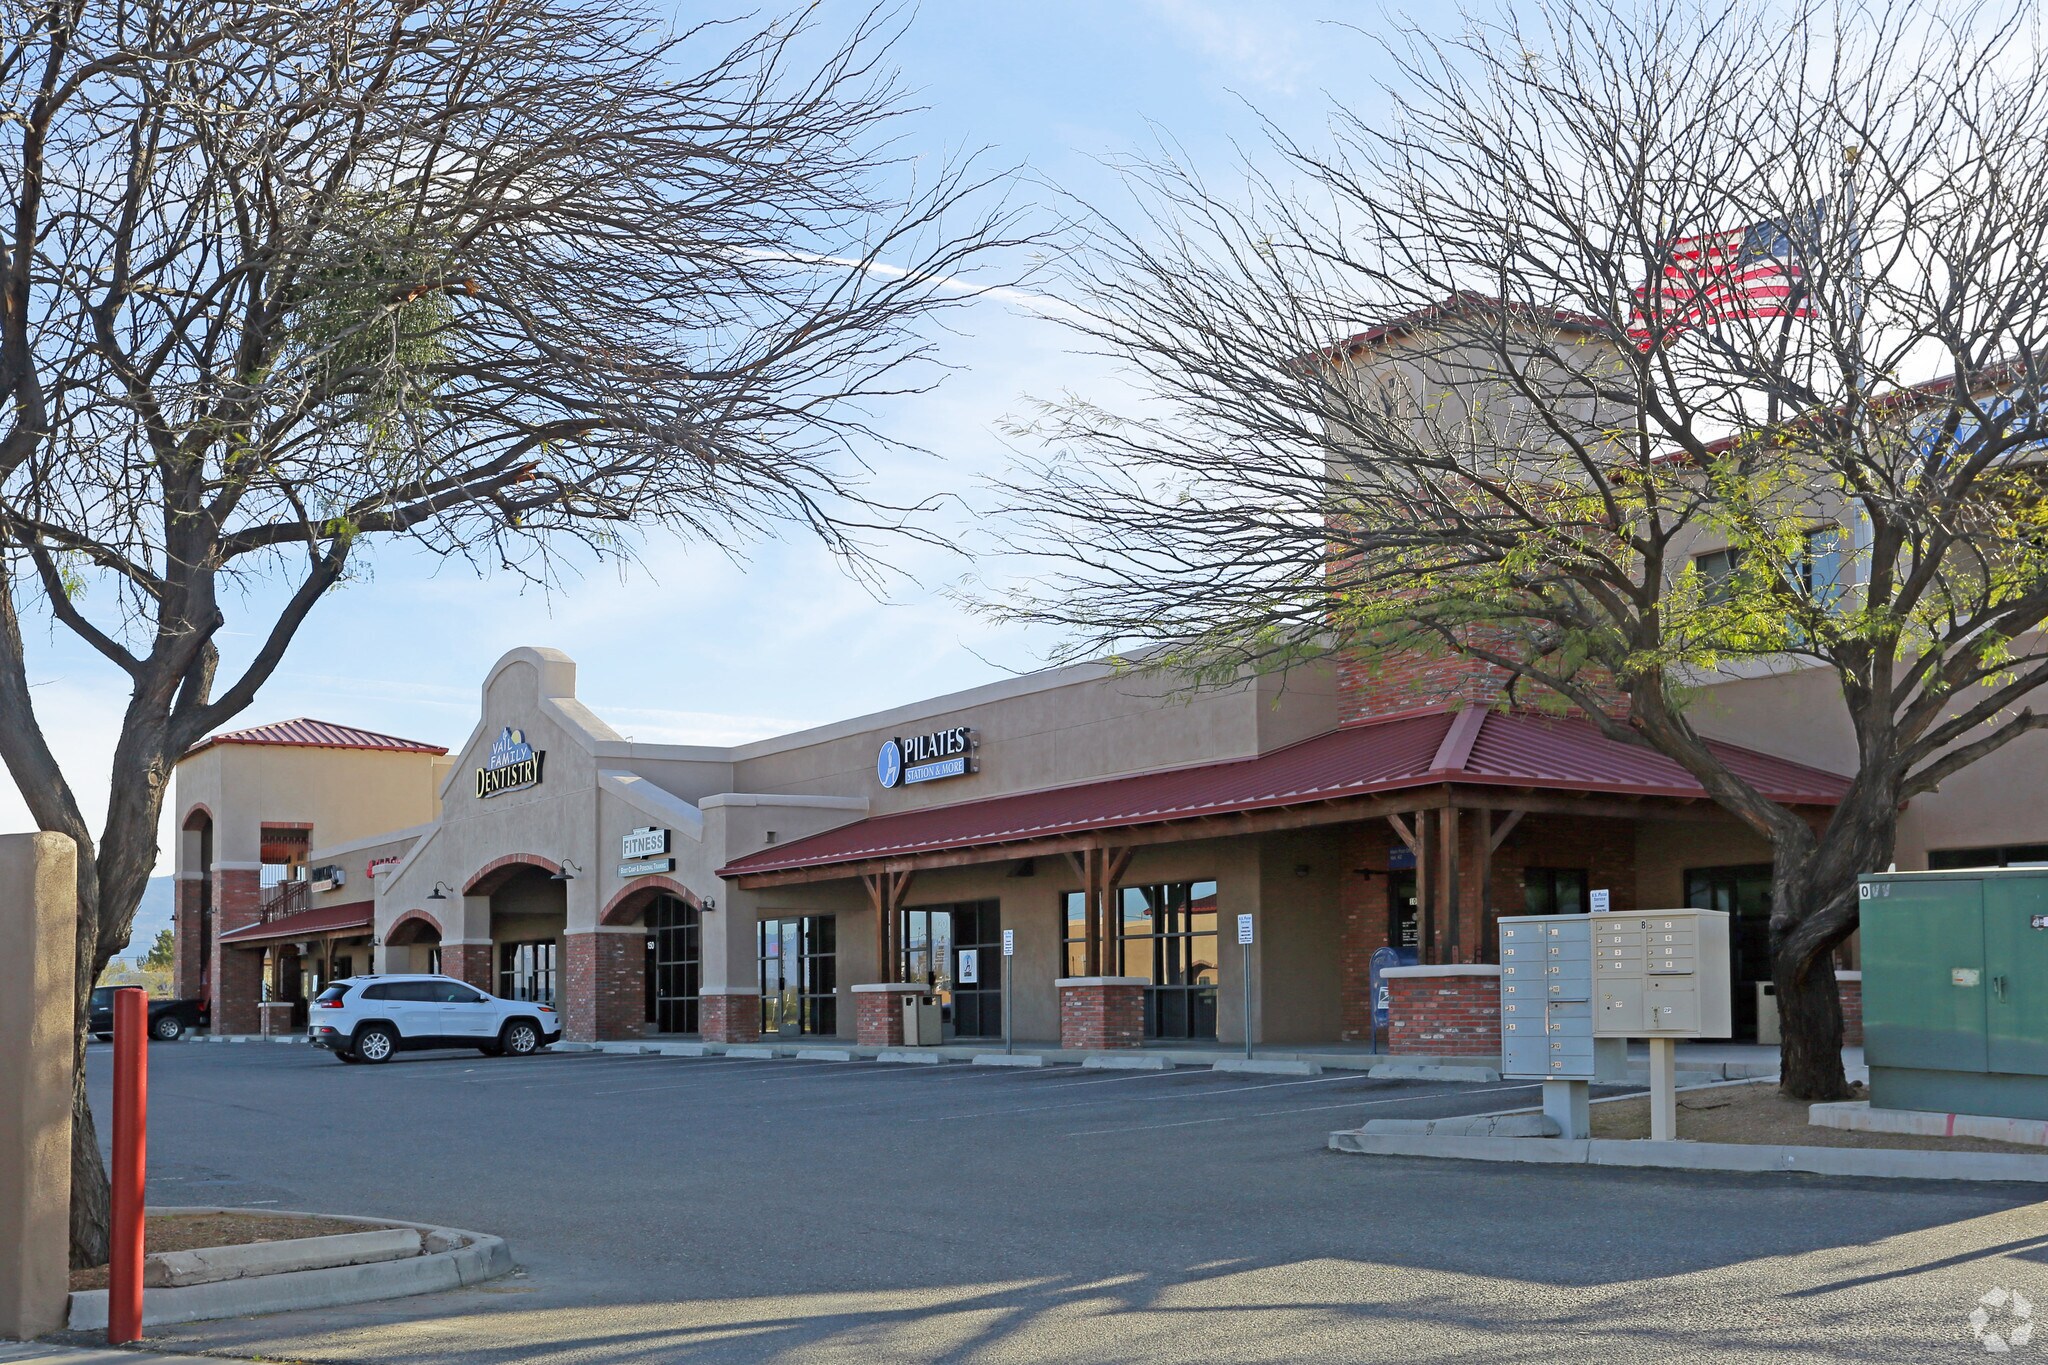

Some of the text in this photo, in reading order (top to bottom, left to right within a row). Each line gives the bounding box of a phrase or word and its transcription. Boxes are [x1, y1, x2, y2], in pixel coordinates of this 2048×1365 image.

[492, 735, 513, 754] VAIL
[905, 727, 964, 763] PILATES
[491, 747, 528, 769] FAMILY
[476, 750, 541, 798] DENTISTRY
[907, 761, 962, 781] STATION & MORE
[623, 834, 663, 855] FITNESS
